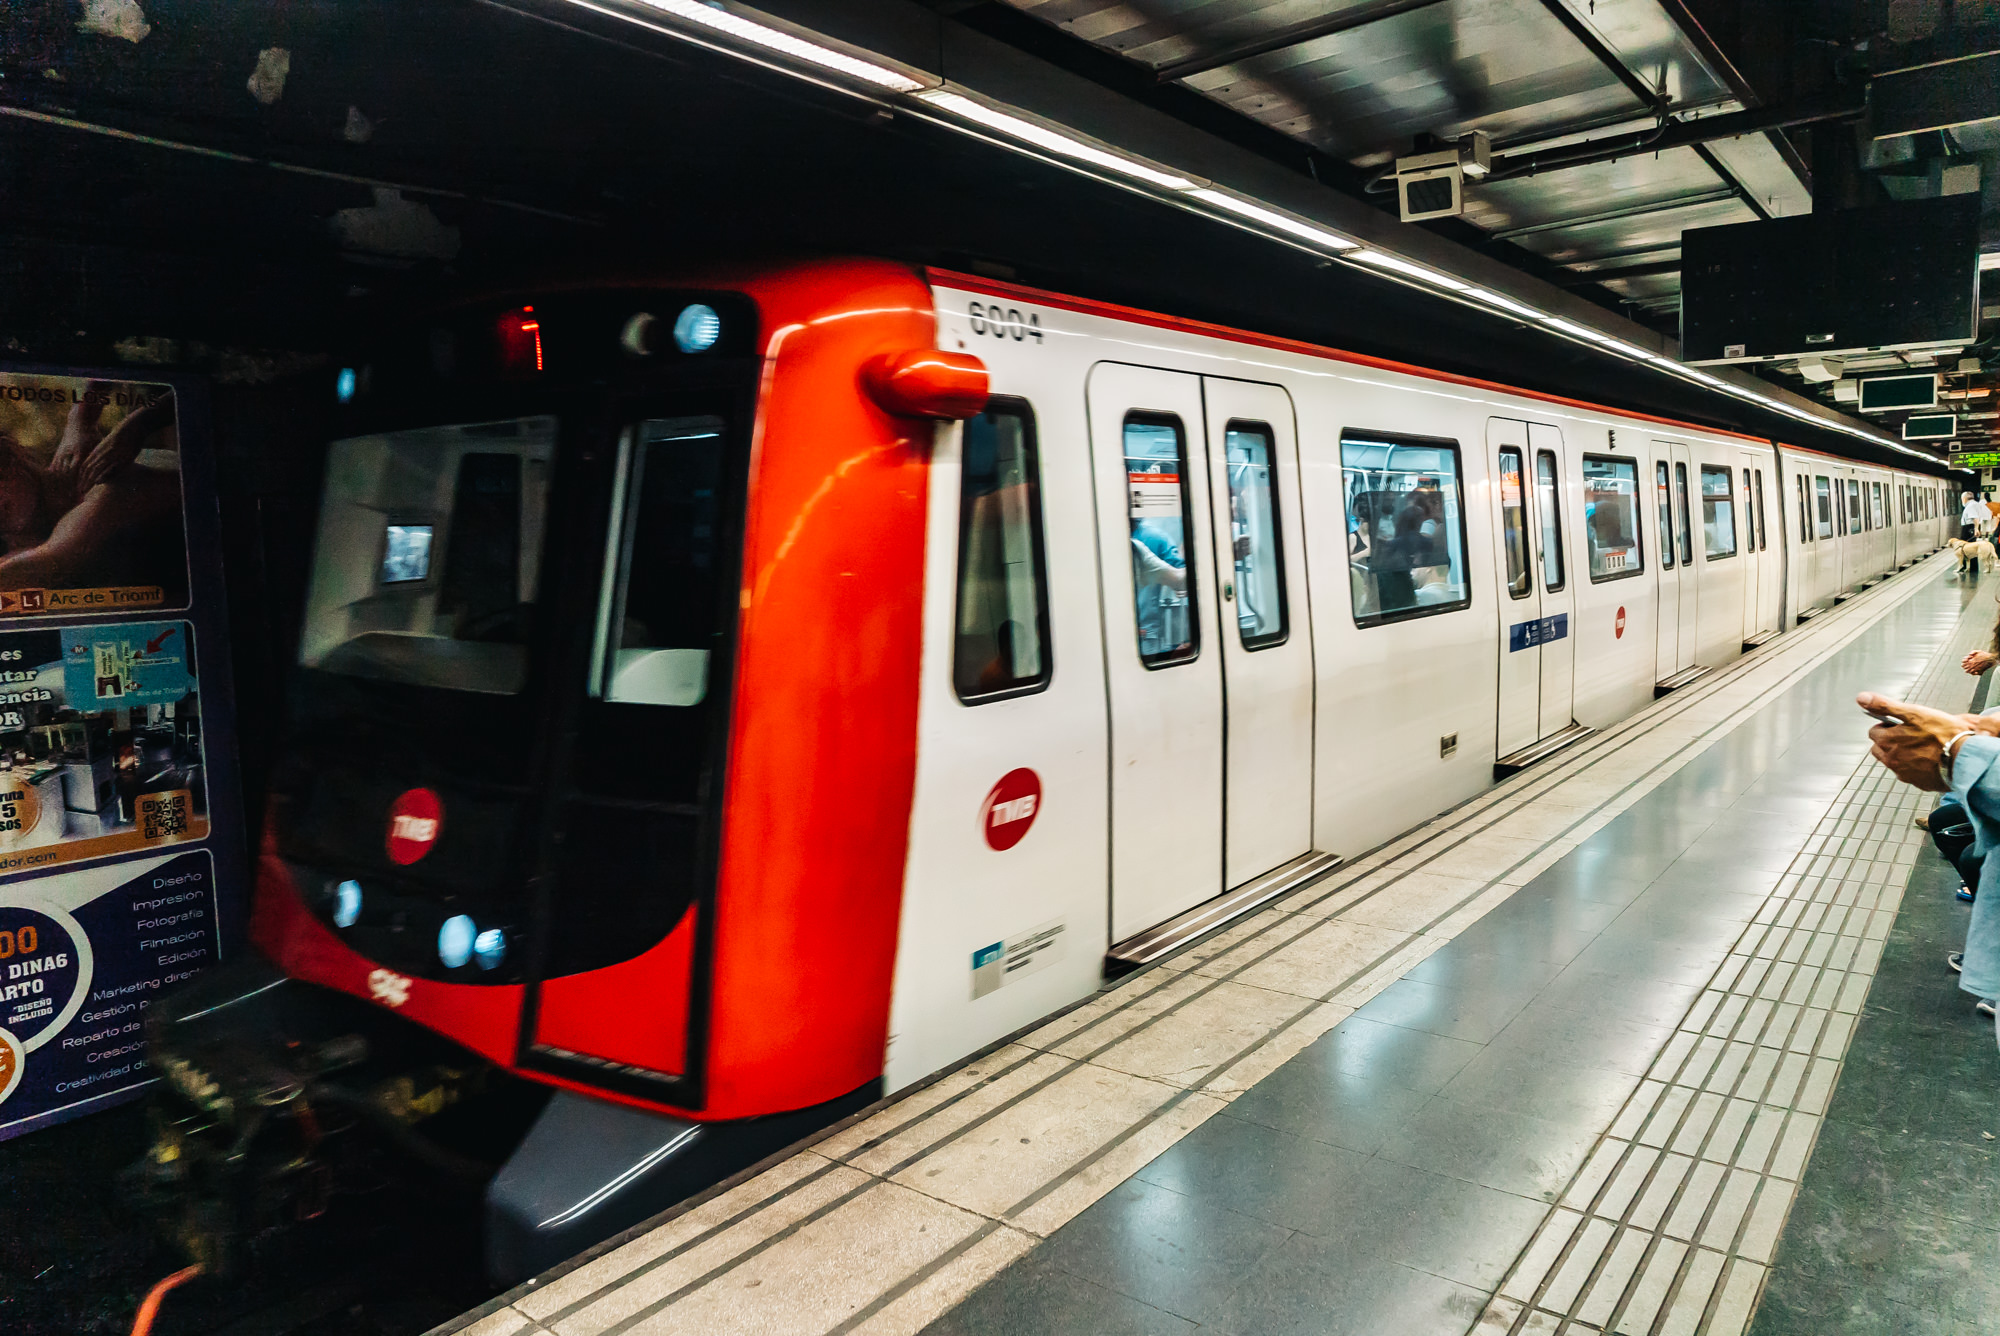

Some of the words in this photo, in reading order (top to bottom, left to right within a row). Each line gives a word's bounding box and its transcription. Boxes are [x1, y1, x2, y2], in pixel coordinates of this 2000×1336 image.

[969, 301, 1043, 344] 6004
[73, 390, 110, 406] LOS
[22, 595, 41, 607] L1
[49, 592, 78, 605] Arc
[83, 591, 104, 604] de
[109, 588, 161, 603] Triomf
[0, 649, 23, 661] es
[2, 803, 16, 818] 5
[153, 872, 203, 889] Diseño
[140, 928, 206, 951] Filmación
[8, 953, 68, 980] DINA6
[158, 947, 207, 966] Edición
[93, 978, 160, 1002] Marketing
[8, 1006, 53, 1024] INCLUIDO
[81, 1001, 136, 1024] Gestión
[62, 1027, 120, 1050] Reparto
[123, 1021, 141, 1034] de
[55, 1063, 130, 1093] Creatividad
